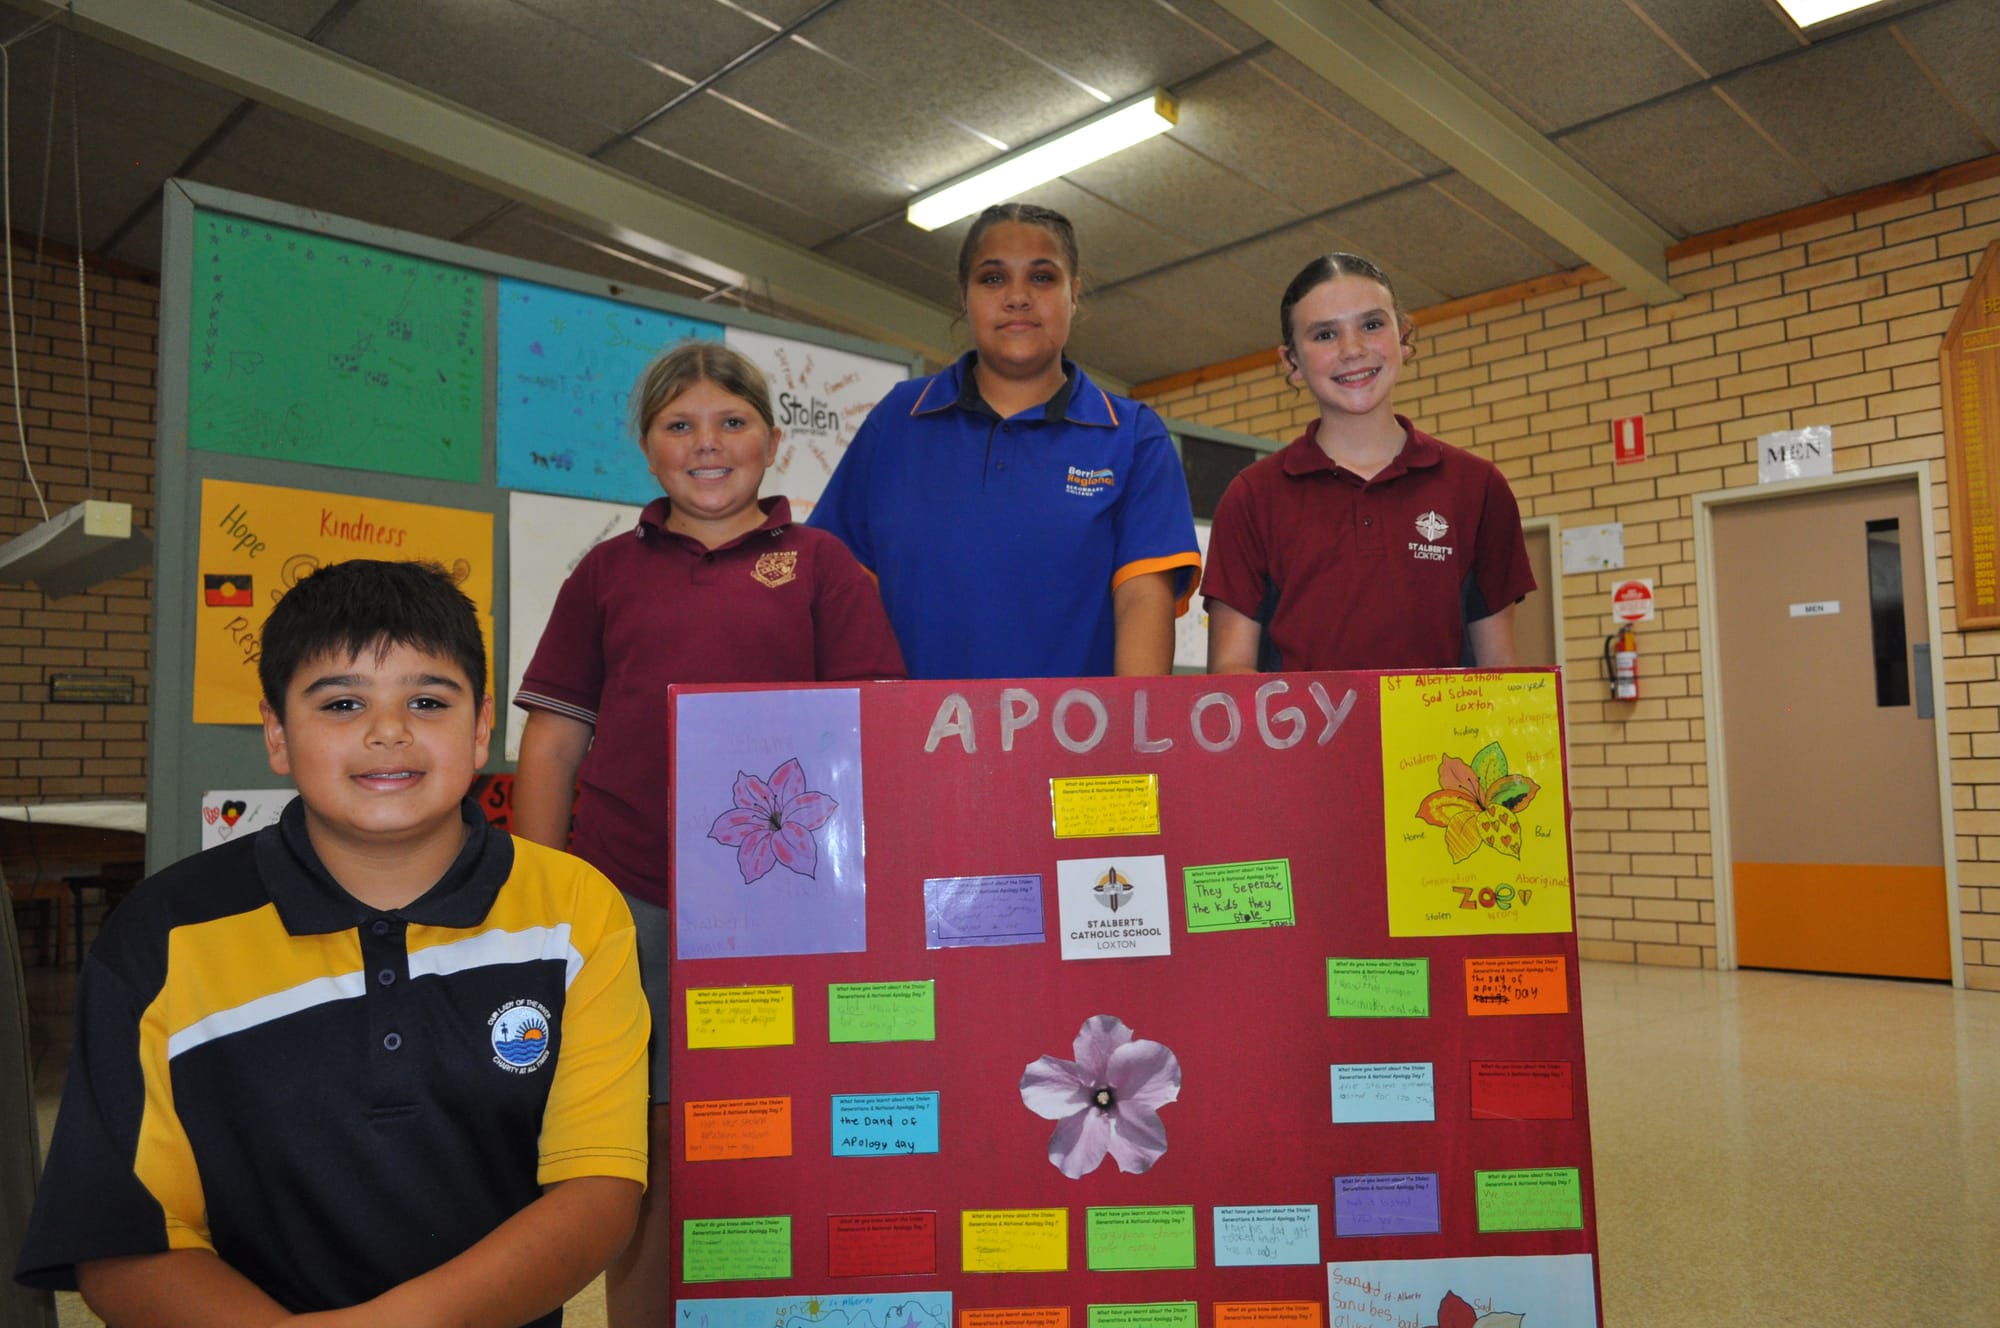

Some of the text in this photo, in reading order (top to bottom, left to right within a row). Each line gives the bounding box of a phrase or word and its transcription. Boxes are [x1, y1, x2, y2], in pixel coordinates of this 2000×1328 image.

[779, 392, 839, 432] Stolen
[1767, 441, 1821, 465] MEN
[1068, 465, 1095, 479] Berri
[1067, 474, 1114, 487] Regional
[219, 503, 267, 559] Hope
[320, 508, 408, 548] Kindness
[1414, 551, 1445, 561] LOXTON
[1804, 605, 1824, 613] MEN
[1449, 686, 1483, 700] School
[923, 680, 1358, 755] APOLOGY
[1195, 884, 1222, 899] They
[1193, 902, 1211, 914] the
[1248, 896, 1272, 912] they
[1087, 917, 1144, 928] ST ALBERT'S
[1070, 927, 1162, 940] CATHOLIC SCHOOL
[1097, 940, 1137, 950] LOXTON
[840, 1116, 860, 1126] the
